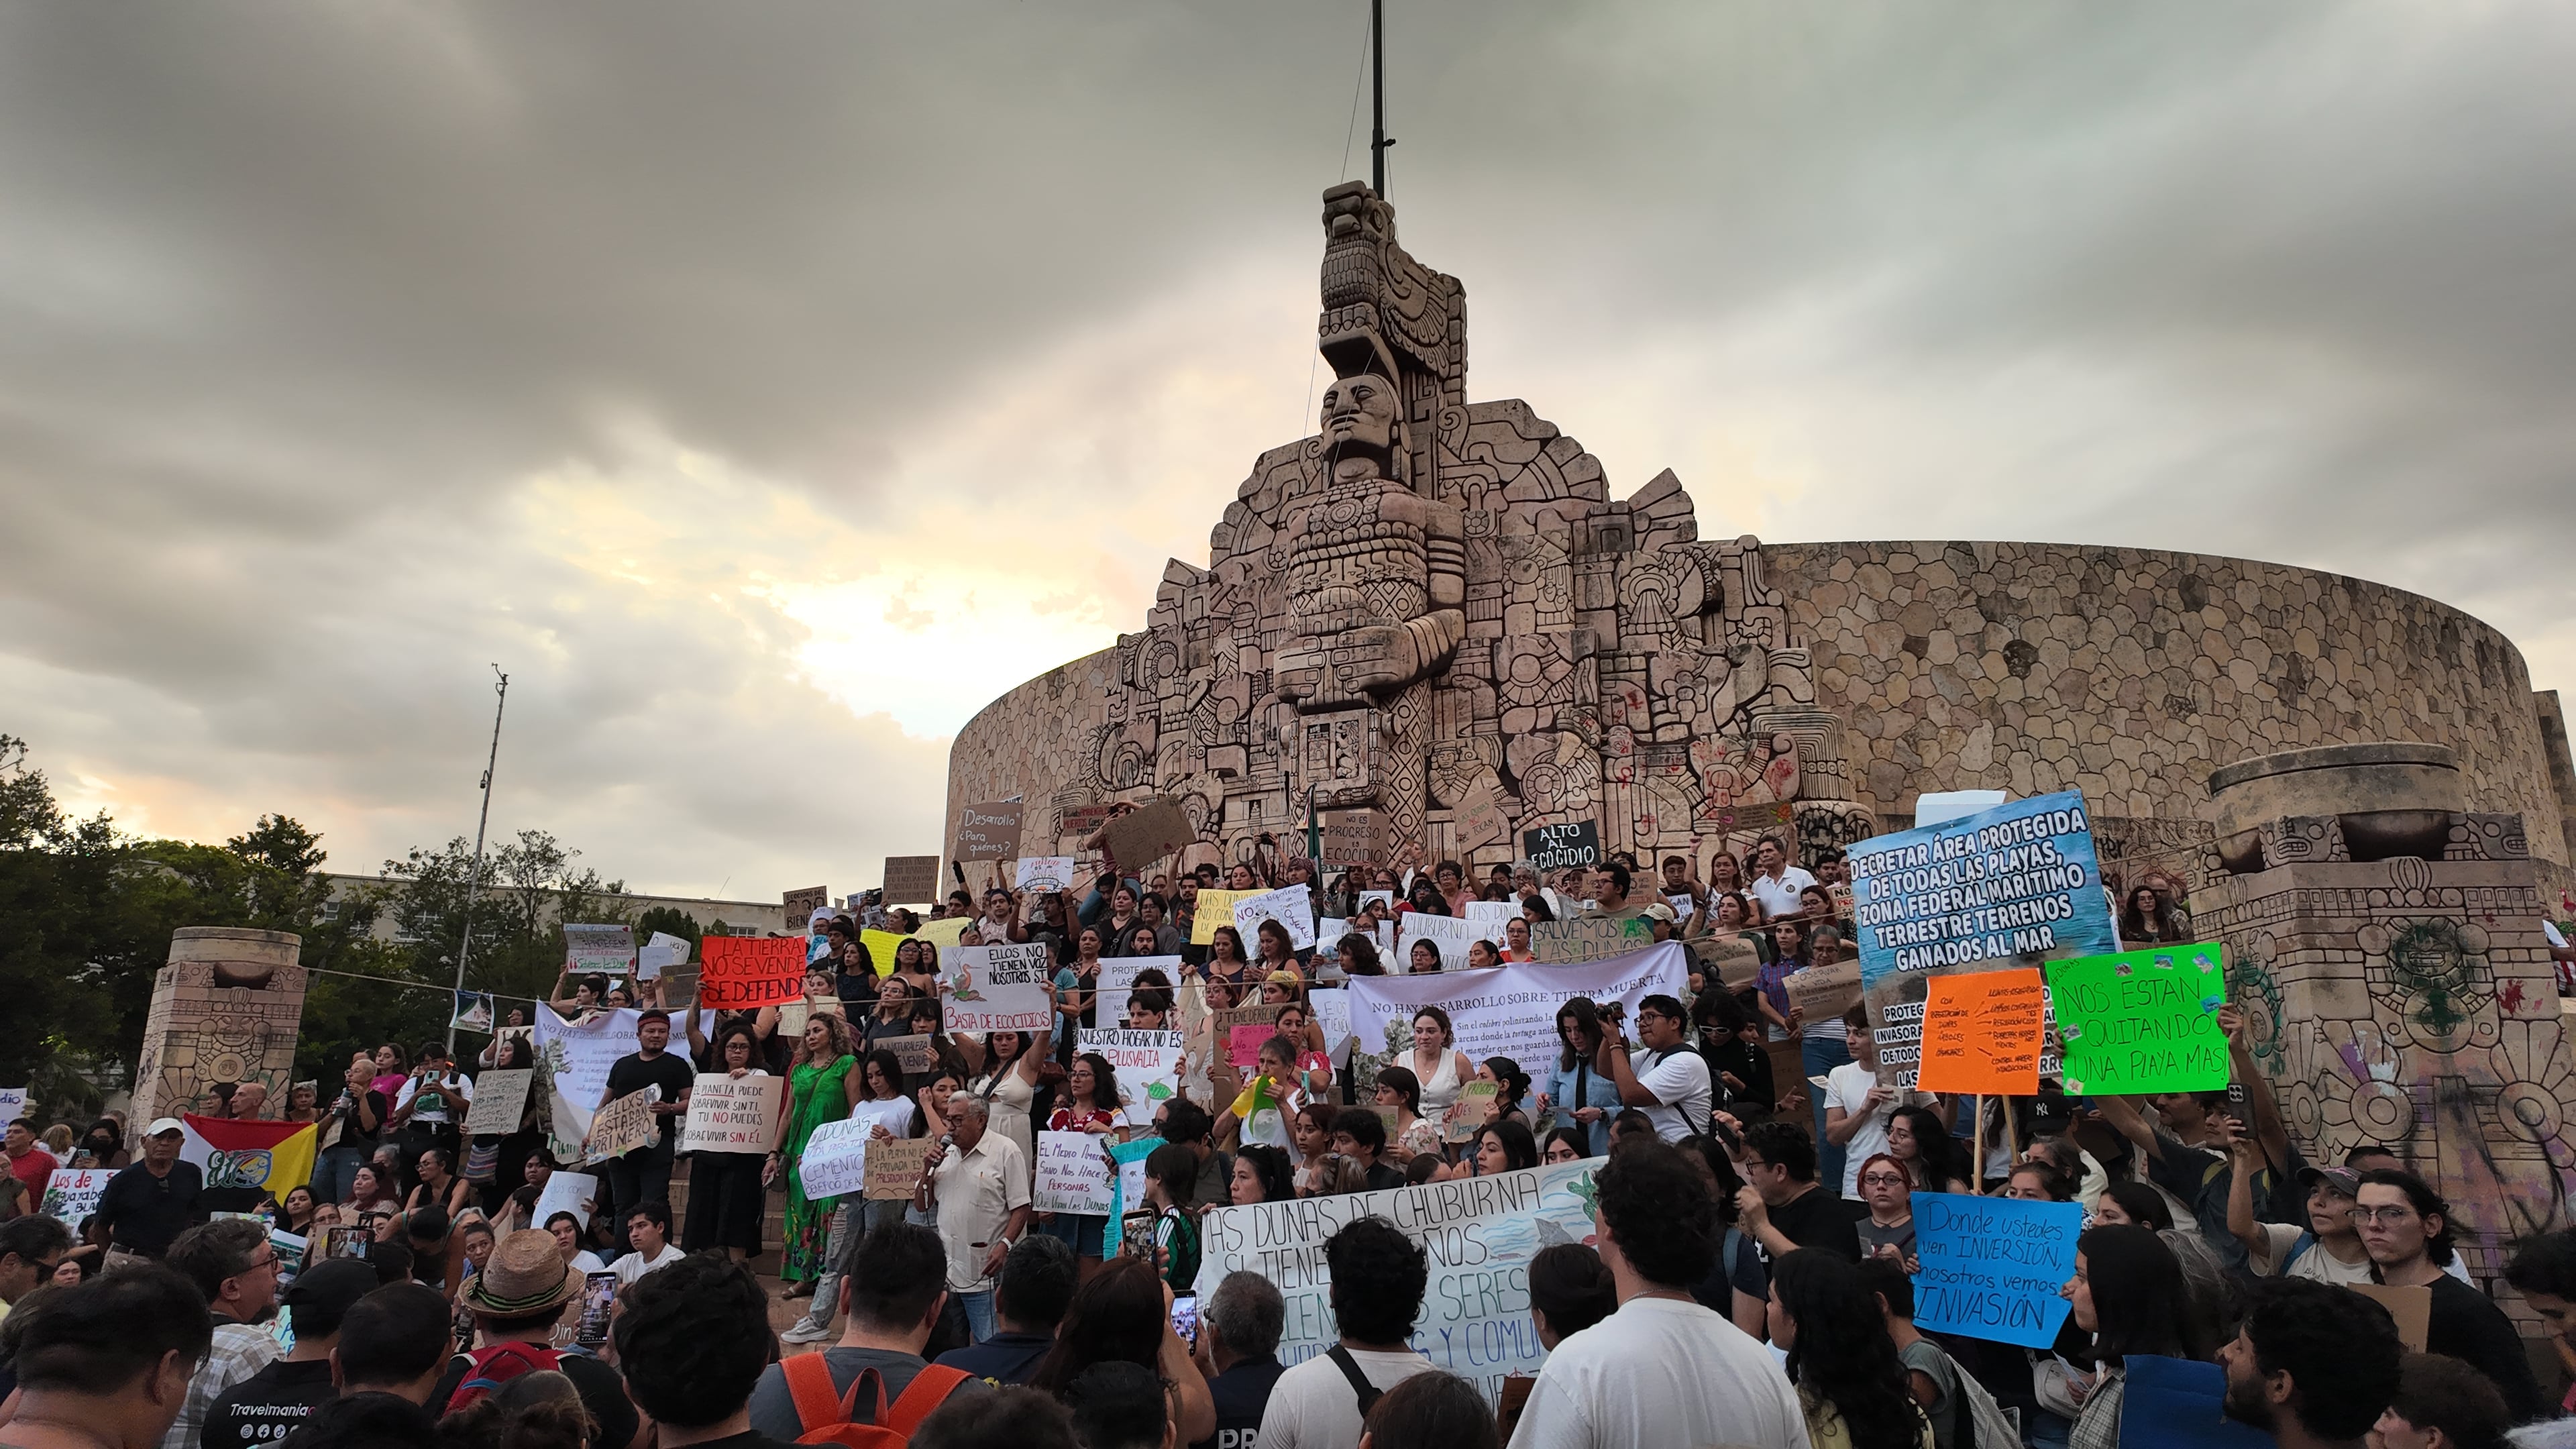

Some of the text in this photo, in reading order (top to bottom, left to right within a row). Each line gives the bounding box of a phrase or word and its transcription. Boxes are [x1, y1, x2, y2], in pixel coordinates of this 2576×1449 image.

[1359, 816, 1368, 824] ES
[959, 830, 985, 841] ¿Para
[1328, 825, 1380, 840] PROGRESO
[1540, 824, 1580, 841] ALTO
[1548, 839, 1568, 849] AL
[1849, 807, 2088, 881] DECRETAR ÁREA PROTEGIDA
[1326, 847, 1383, 863] ECOCIDIO
[1531, 845, 1595, 869] ECOCIDIO
[1869, 841, 2063, 901] DE TODAS LAS PLAYAS,
[1200, 892, 1219, 906] LAS
[1835, 888, 1851, 897] NO
[1860, 863, 2085, 927] ZONA FEDERAL MARÍTIMO
[1198, 908, 1212, 920] NO
[1236, 907, 1254, 923] NO
[1875, 894, 2073, 950] TERRESTRE TERRENOS
[1403, 914, 1469, 940] CHUBURNA
[1535, 918, 1618, 941] SALVEMOS
[722, 938, 802, 957] LA TIERRA
[989, 945, 1043, 961] ELLOS NO
[1537, 941, 1572, 965] LAS
[1894, 925, 2056, 972] GANADOS AL MAR
[701, 955, 806, 977] NO SE VENDE
[989, 957, 1047, 972] TIENEN VOZ
[989, 971, 1031, 985] NOSOTROS
[705, 979, 731, 1002] SE
[1373, 1003, 1391, 1014] NO
[1395, 1004, 1419, 1014] HAY
[1507, 991, 1549, 1005] SOBRE
[1608, 973, 1665, 996] MUERTA
[2061, 976, 2200, 1017] NOS ESTAN
[980, 1014, 994, 1029] DE
[996, 1011, 1051, 1029] ECOCIDIOS
[1883, 1003, 1925, 1022] PROTEG
[1456, 1022, 1469, 1030] Sin
[1502, 1015, 1544, 1027] polinizando
[2084, 1014, 2212, 1048] QUITANDO
[1079, 1029, 1183, 1048] NUESTRO HOGAR NO ES
[1481, 1033, 1503, 1041] donde
[1512, 1029, 1536, 1038] tortuga
[886, 1040, 928, 1053] NATURALEZA
[1465, 1041, 1550, 1056] manglar que nos guarda
[1108, 1049, 1160, 1068] PLUSVALIA
[1517, 1055, 1540, 1066] pierde
[1880, 1049, 1895, 1065] DE
[2074, 1042, 2228, 1083] UNA PLAYA MAS!
[694, 1085, 700, 1095] EL
[739, 1085, 764, 1096] PUEDE
[606, 1091, 643, 1118] ELLXS
[691, 1098, 730, 1110] SOBREVIVIR
[733, 1101, 747, 1112] SIN
[597, 1106, 647, 1138] ESTABAN
[698, 1112, 763, 1126] TU NO PUEDES
[820, 1115, 871, 1141] DUNAS
[594, 1118, 651, 1155] PRIMERO
[685, 1128, 763, 1143] SOBREVIVIR SIN ÉL
[875, 1150, 885, 1161] LA
[908, 1148, 918, 1157] NO
[1039, 1141, 1050, 1157] EL
[805, 1153, 865, 1182] CEMENTO
[879, 1161, 908, 1172] PRIVADA
[1078, 1165, 1101, 1179] HACE
[74, 1171, 92, 1188] de
[1047, 1178, 1090, 1193] PERSONAS
[1253, 1198, 1340, 1248] DUNAS
[1393, 1173, 1542, 1229] CHUBURNA
[1926, 1200, 2063, 1241] Donde ustedes
[1922, 1236, 2063, 1271] ven INVERSIÓN,
[1917, 1264, 2058, 1296] nosotros vemos
[1439, 1267, 1532, 1322] SERES
[1914, 1286, 2045, 1331] INVASIÓN
[1439, 1326, 1453, 1368] Y
